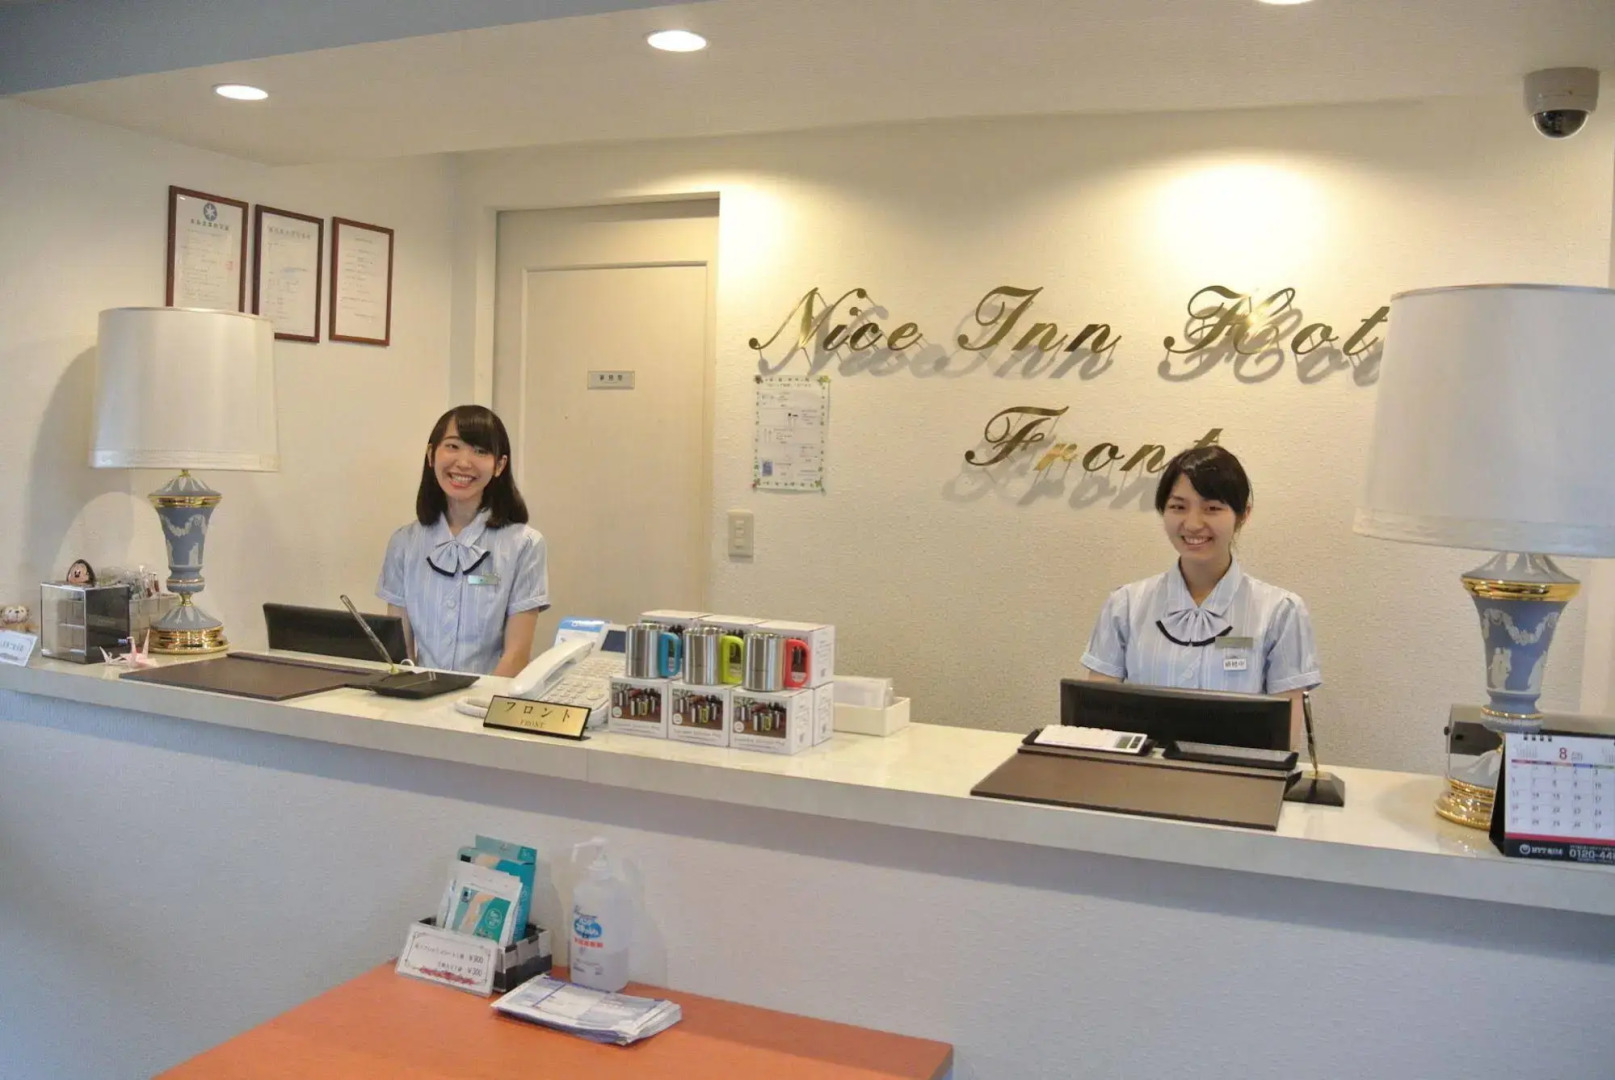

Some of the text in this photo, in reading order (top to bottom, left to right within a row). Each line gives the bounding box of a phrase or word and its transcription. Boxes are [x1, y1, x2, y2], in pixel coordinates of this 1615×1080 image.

[749, 286, 923, 352] Nice
[958, 285, 1122, 354] Inn
[506, 701, 571, 723] フロント
[1559, 747, 1568, 760] 8
